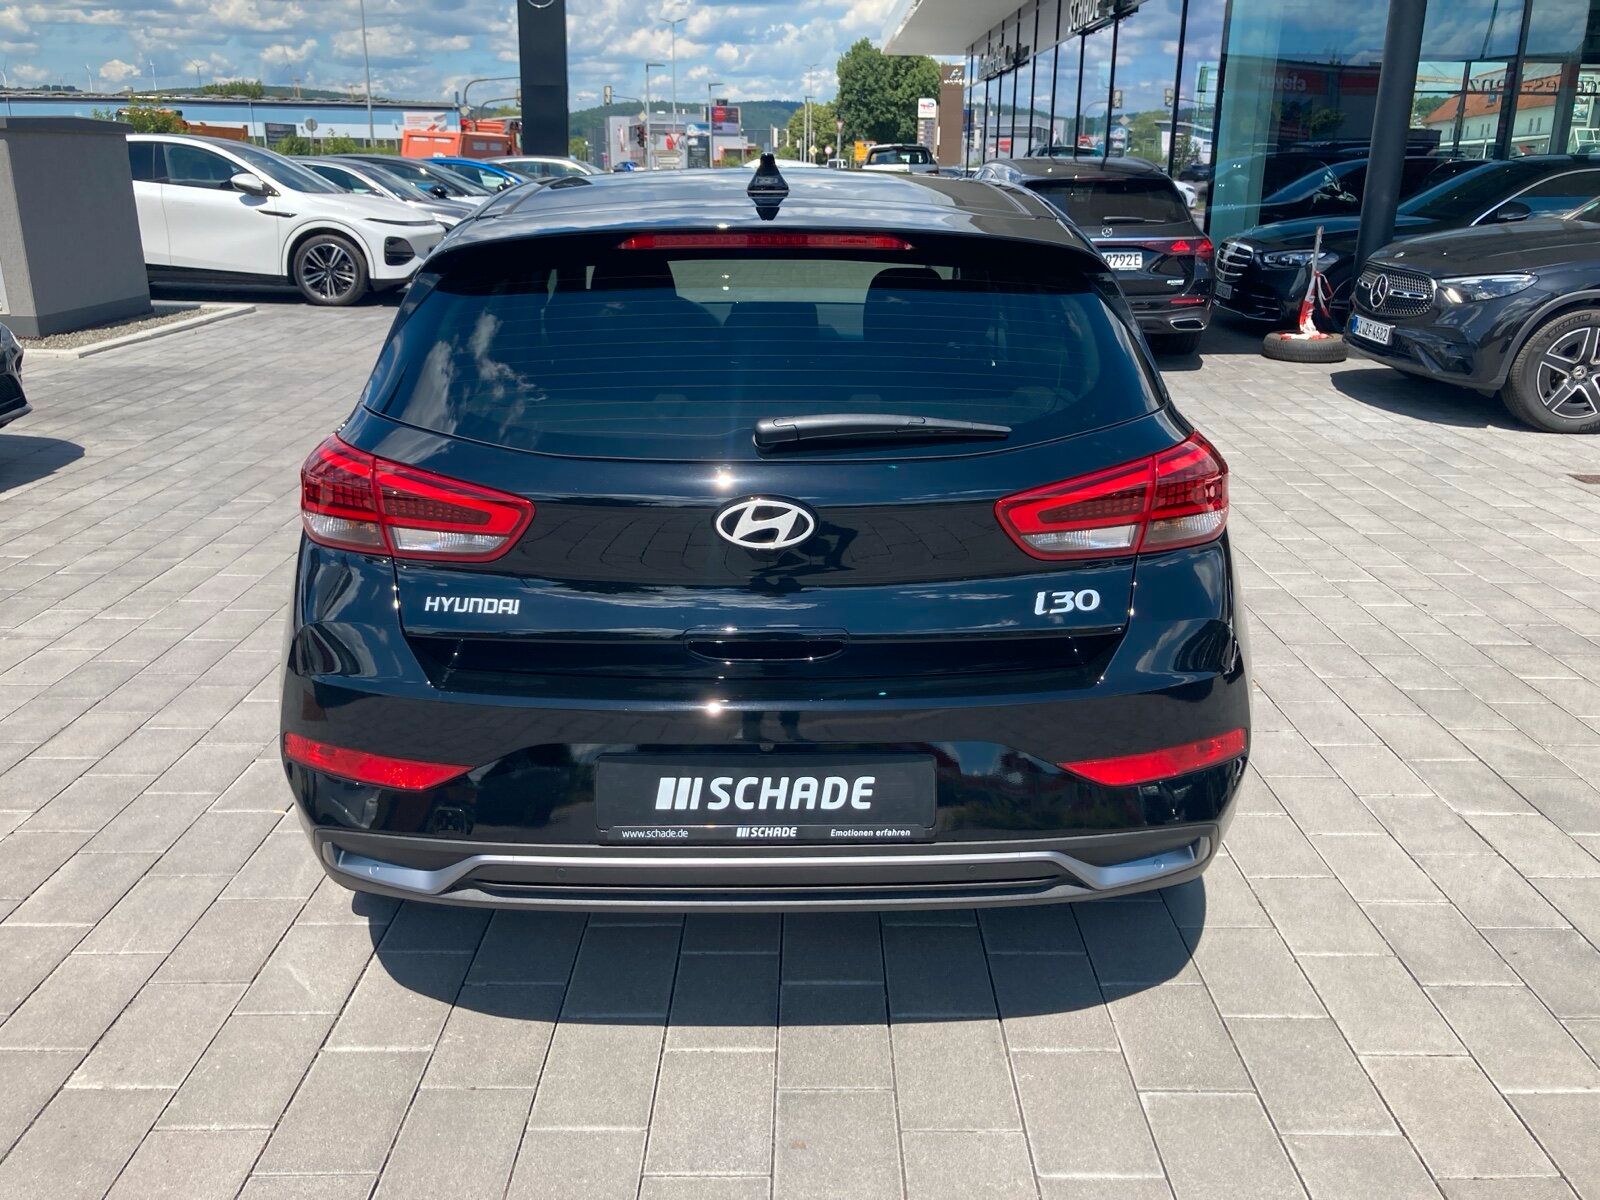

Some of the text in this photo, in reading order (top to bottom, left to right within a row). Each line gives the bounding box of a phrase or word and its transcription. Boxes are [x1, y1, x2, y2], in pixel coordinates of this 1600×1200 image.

[424, 596, 520, 615] HYUNDAI
[707, 776, 876, 810] SCHADE
[621, 826, 911, 838] www.schade.de SCHADE Emotionen erfahren
